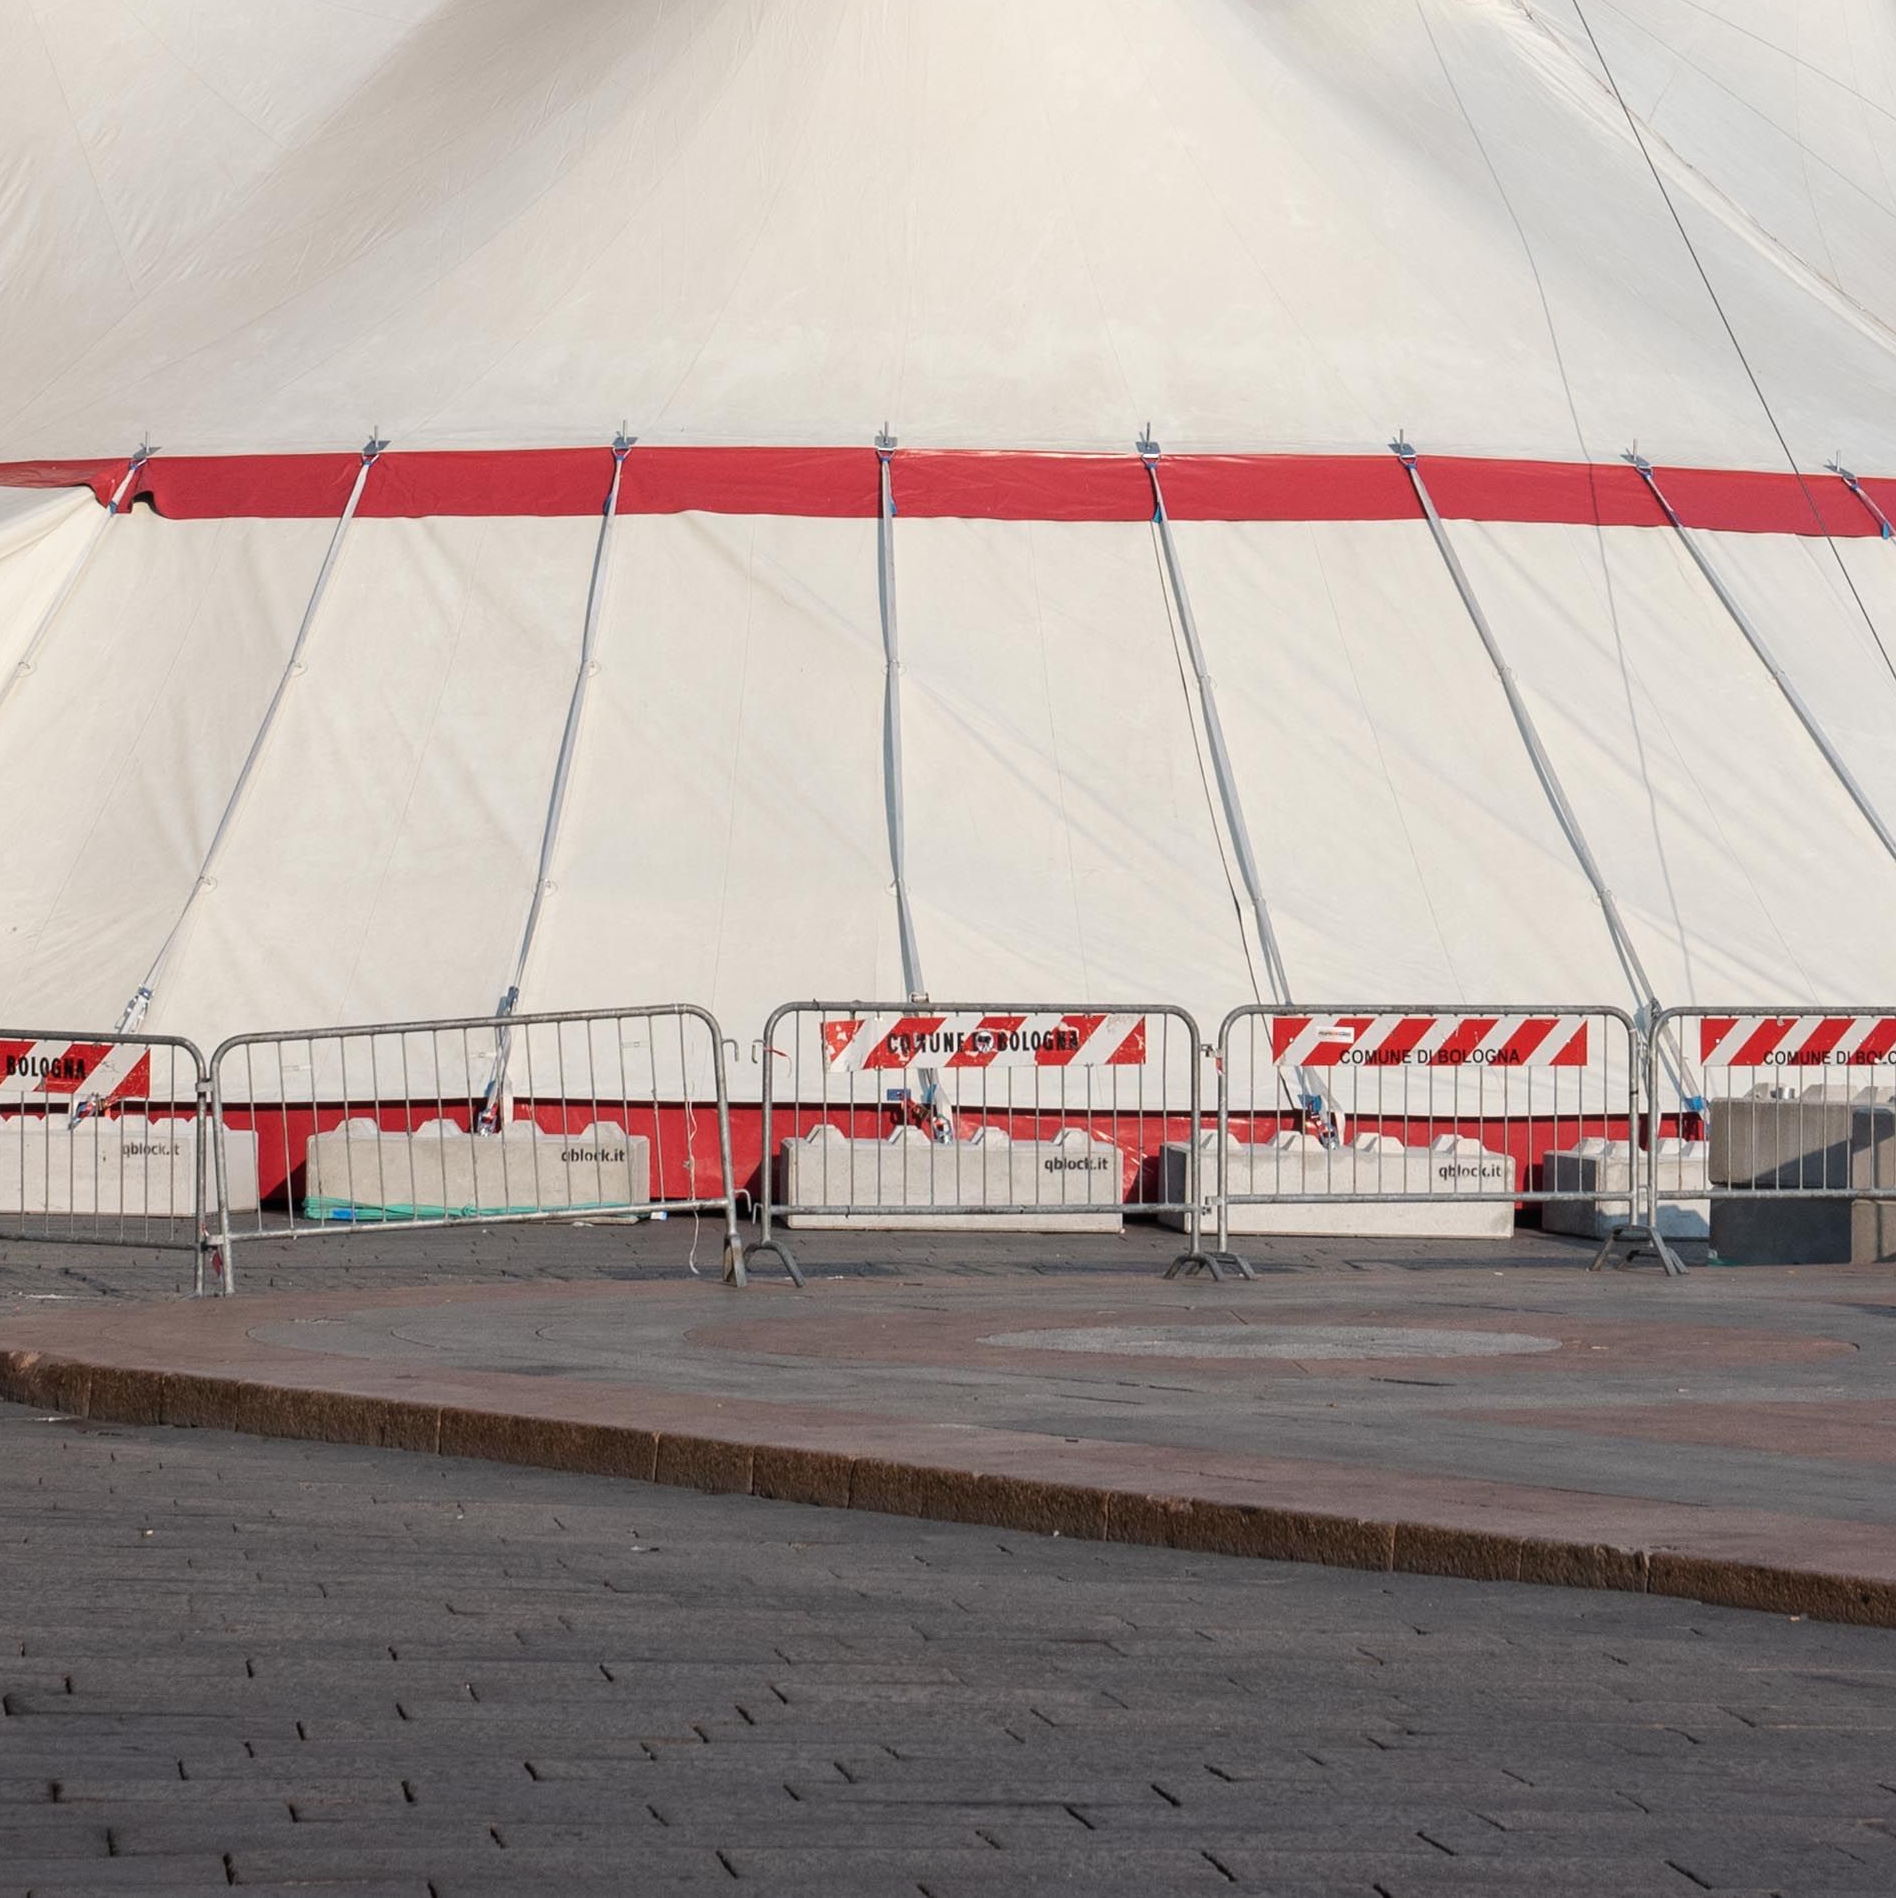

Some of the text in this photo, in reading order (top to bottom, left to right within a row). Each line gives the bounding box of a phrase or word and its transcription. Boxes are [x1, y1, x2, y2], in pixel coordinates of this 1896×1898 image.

[886, 1031, 965, 1053] COMUNE
[997, 1030, 1079, 1052] BOLOGNA
[1339, 1048, 1521, 1065] COMUNE DI BOLOGNA
[1763, 1050, 1831, 1065] COMUNE
[1836, 1050, 1853, 1065] DI
[6, 1054, 86, 1079] BOLOGNA
[121, 1140, 180, 1158] qblock.it
[1043, 1157, 1108, 1173] qblock.it
[1438, 1163, 1502, 1180] qblock.it
